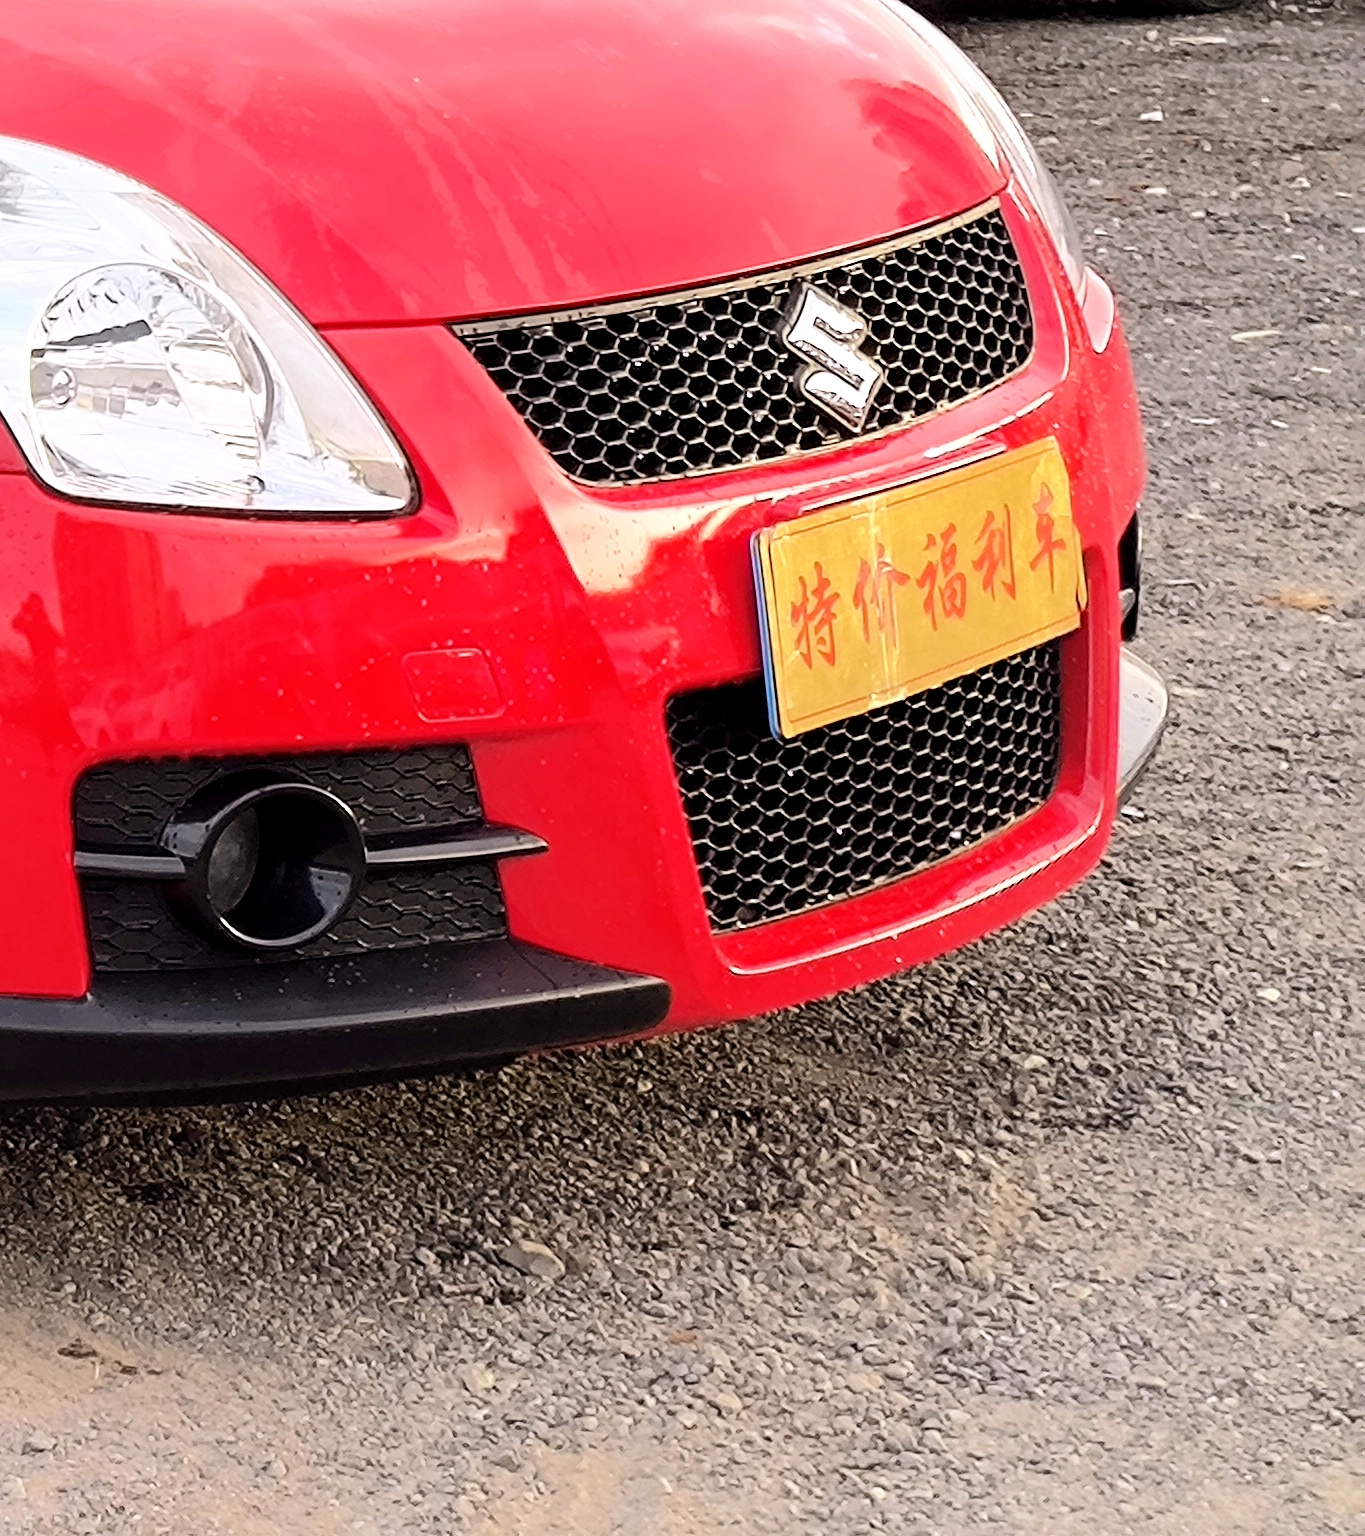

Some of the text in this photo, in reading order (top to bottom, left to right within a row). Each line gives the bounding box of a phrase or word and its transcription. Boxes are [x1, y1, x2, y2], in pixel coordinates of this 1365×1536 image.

[790, 481, 1067, 671] 特价福利车
